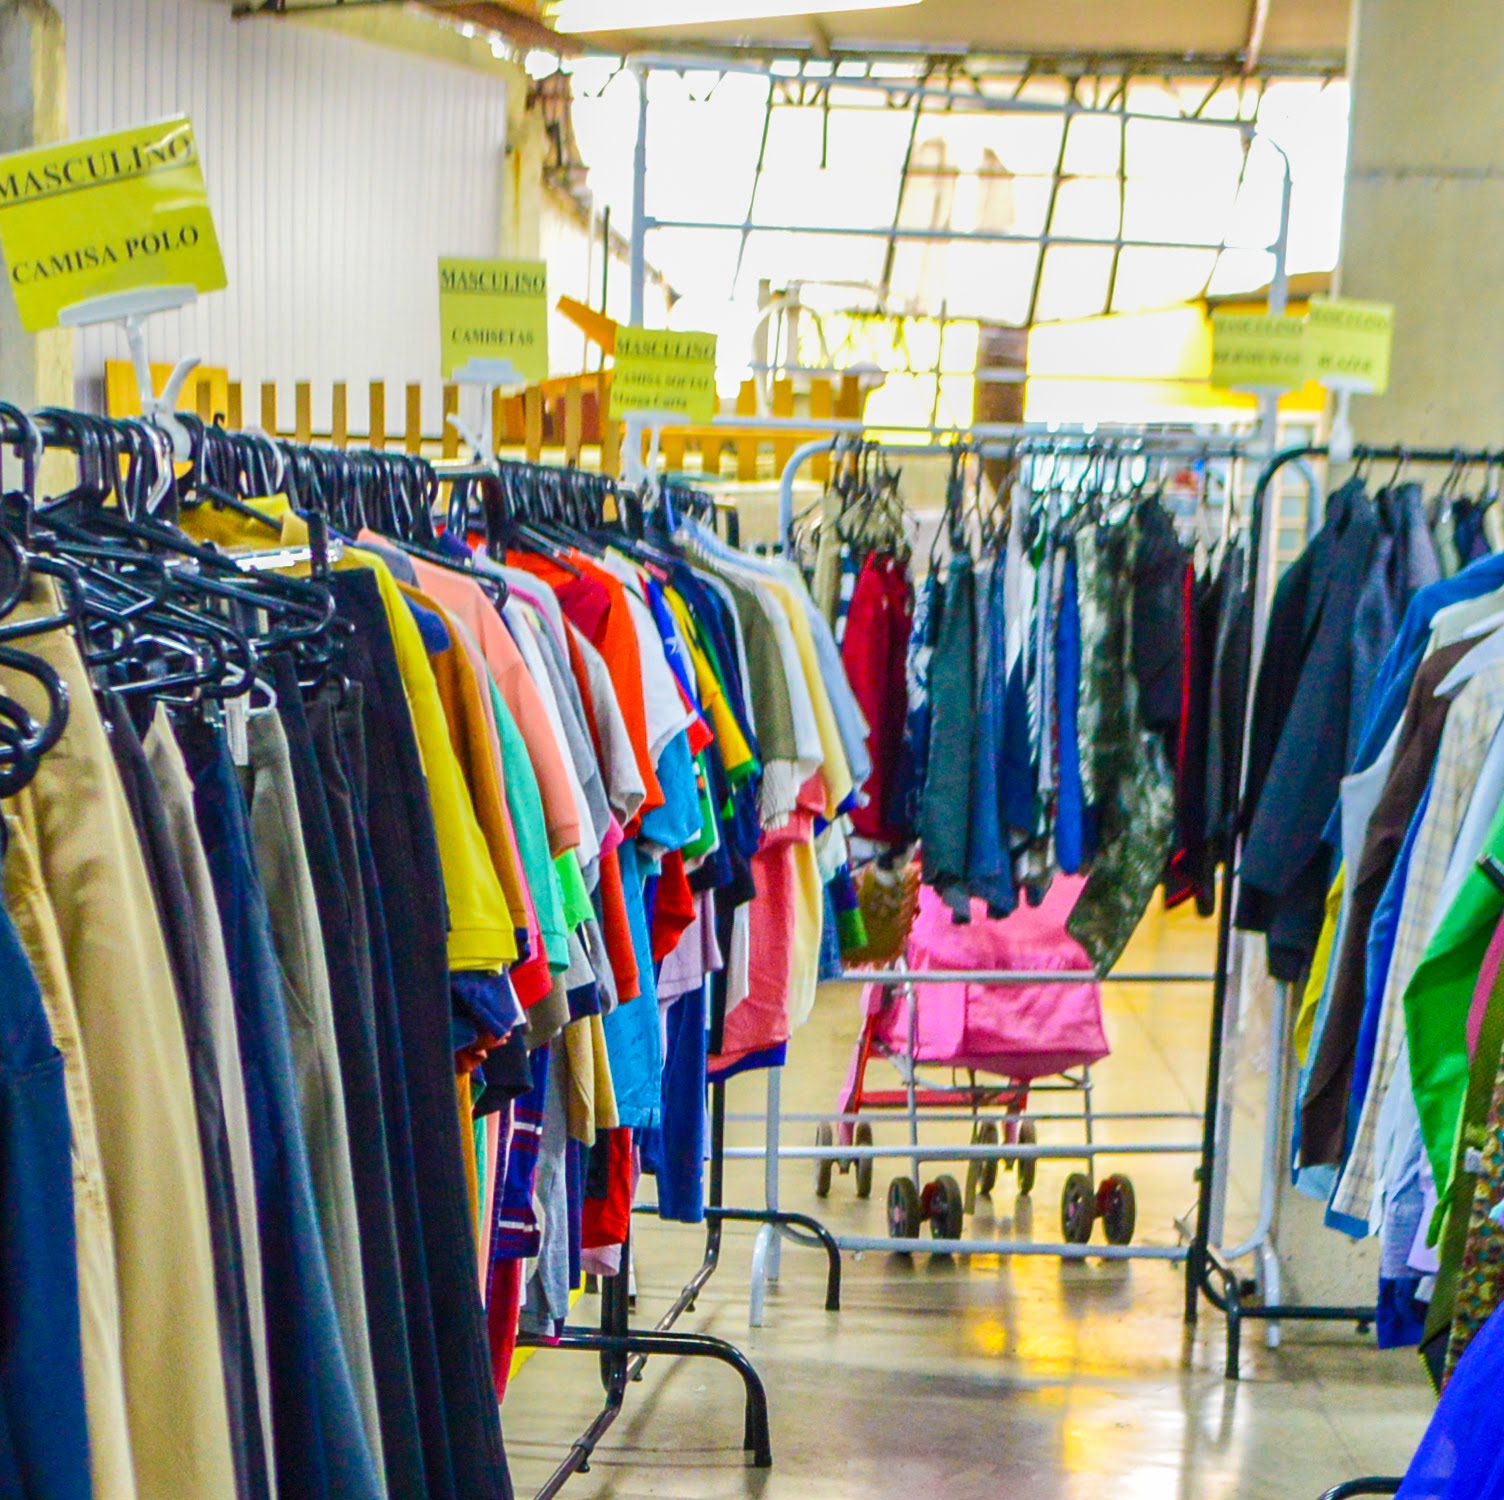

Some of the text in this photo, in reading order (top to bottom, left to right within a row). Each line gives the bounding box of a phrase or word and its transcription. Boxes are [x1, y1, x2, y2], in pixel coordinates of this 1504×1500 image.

[12, 223, 200, 285] CAMISA POLO
[441, 268, 546, 294] MASCULINO
[451, 327, 535, 346] CAMISETAS
[617, 338, 716, 360] MASCULINO
